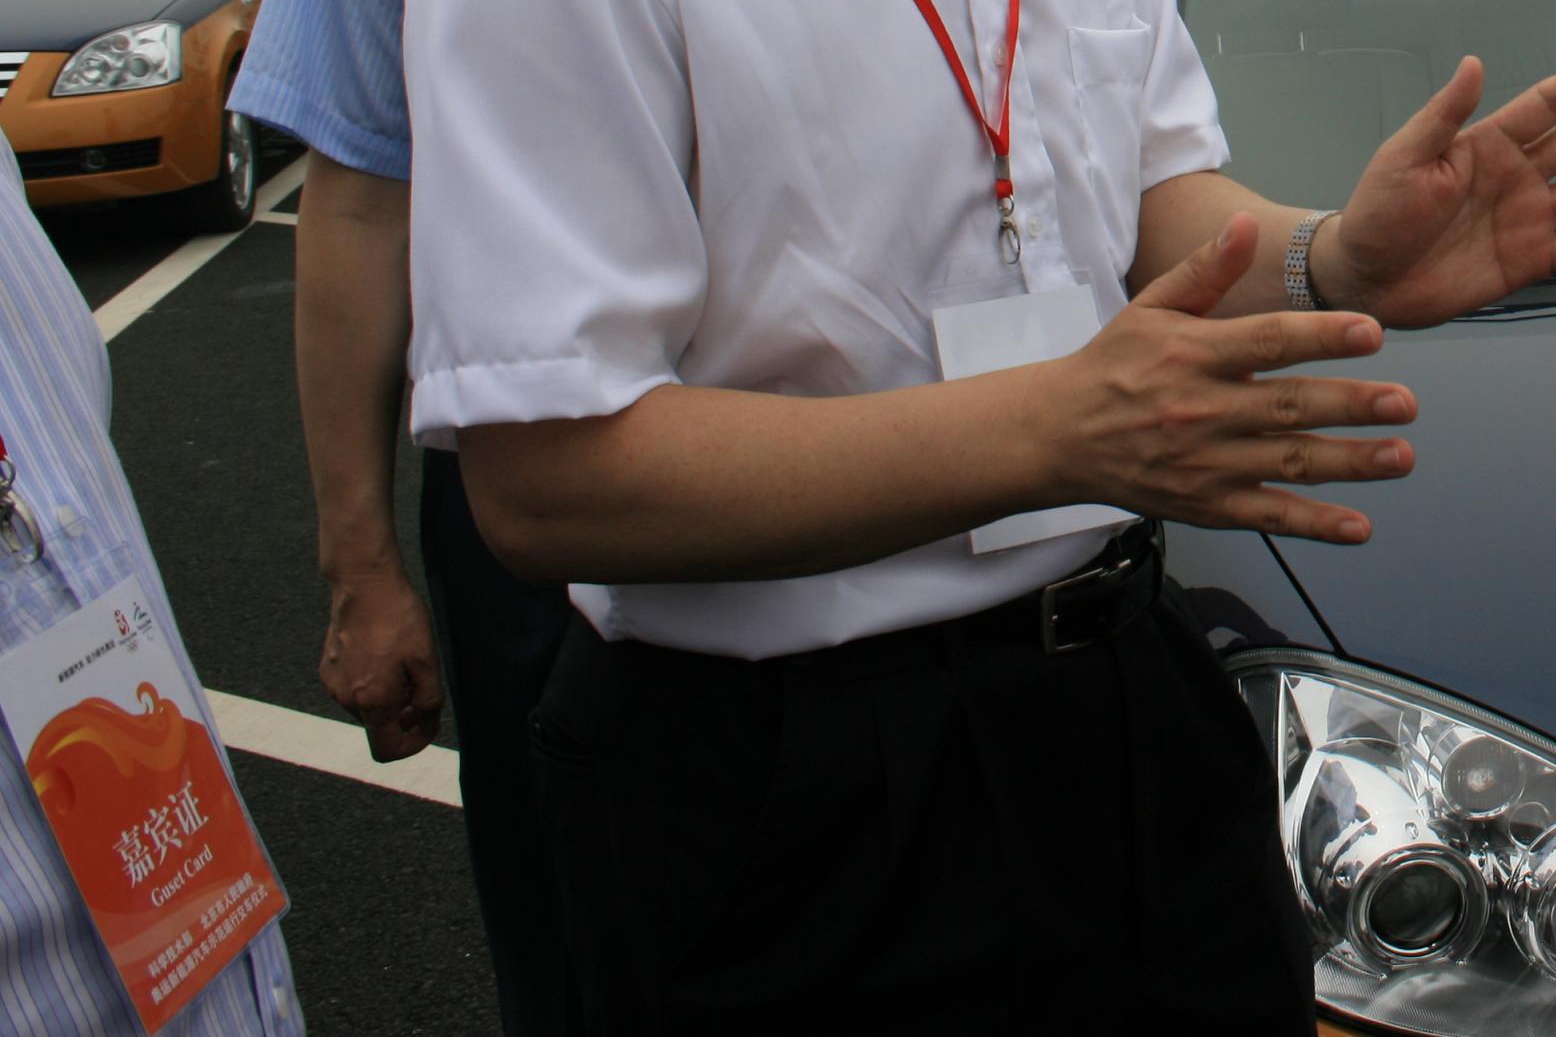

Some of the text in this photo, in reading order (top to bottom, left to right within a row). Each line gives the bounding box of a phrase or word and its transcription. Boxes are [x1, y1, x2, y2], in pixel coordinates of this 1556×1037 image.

[112, 780, 210, 889] 嘉宾证
[183, 843, 214, 879] Card
